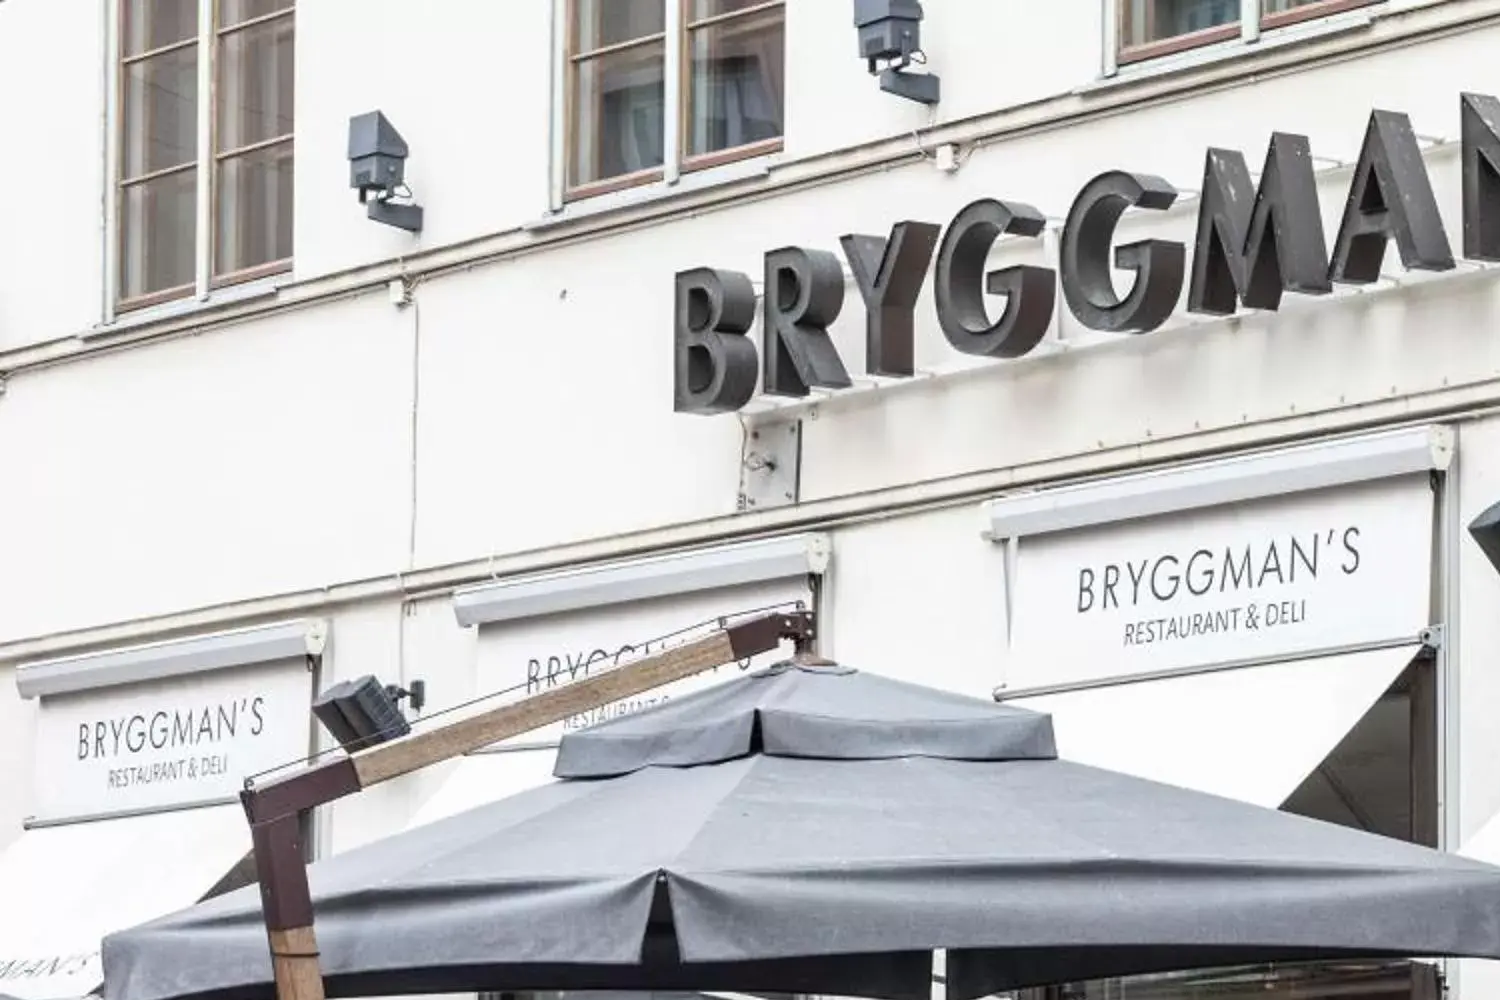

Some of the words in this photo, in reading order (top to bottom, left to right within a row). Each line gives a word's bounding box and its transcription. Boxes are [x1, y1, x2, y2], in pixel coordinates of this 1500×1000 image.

[1077, 527, 1361, 613] BRYGGMAN'S
[1123, 607, 1240, 646] RESTAURANT
[1245, 603, 1261, 630] &
[1266, 599, 1306, 627] DELI
[77, 697, 264, 761] BRYGGMAN'S
[107, 759, 185, 790] RESTAURANT
[187, 760, 199, 779] &
[200, 755, 228, 778] DELI
